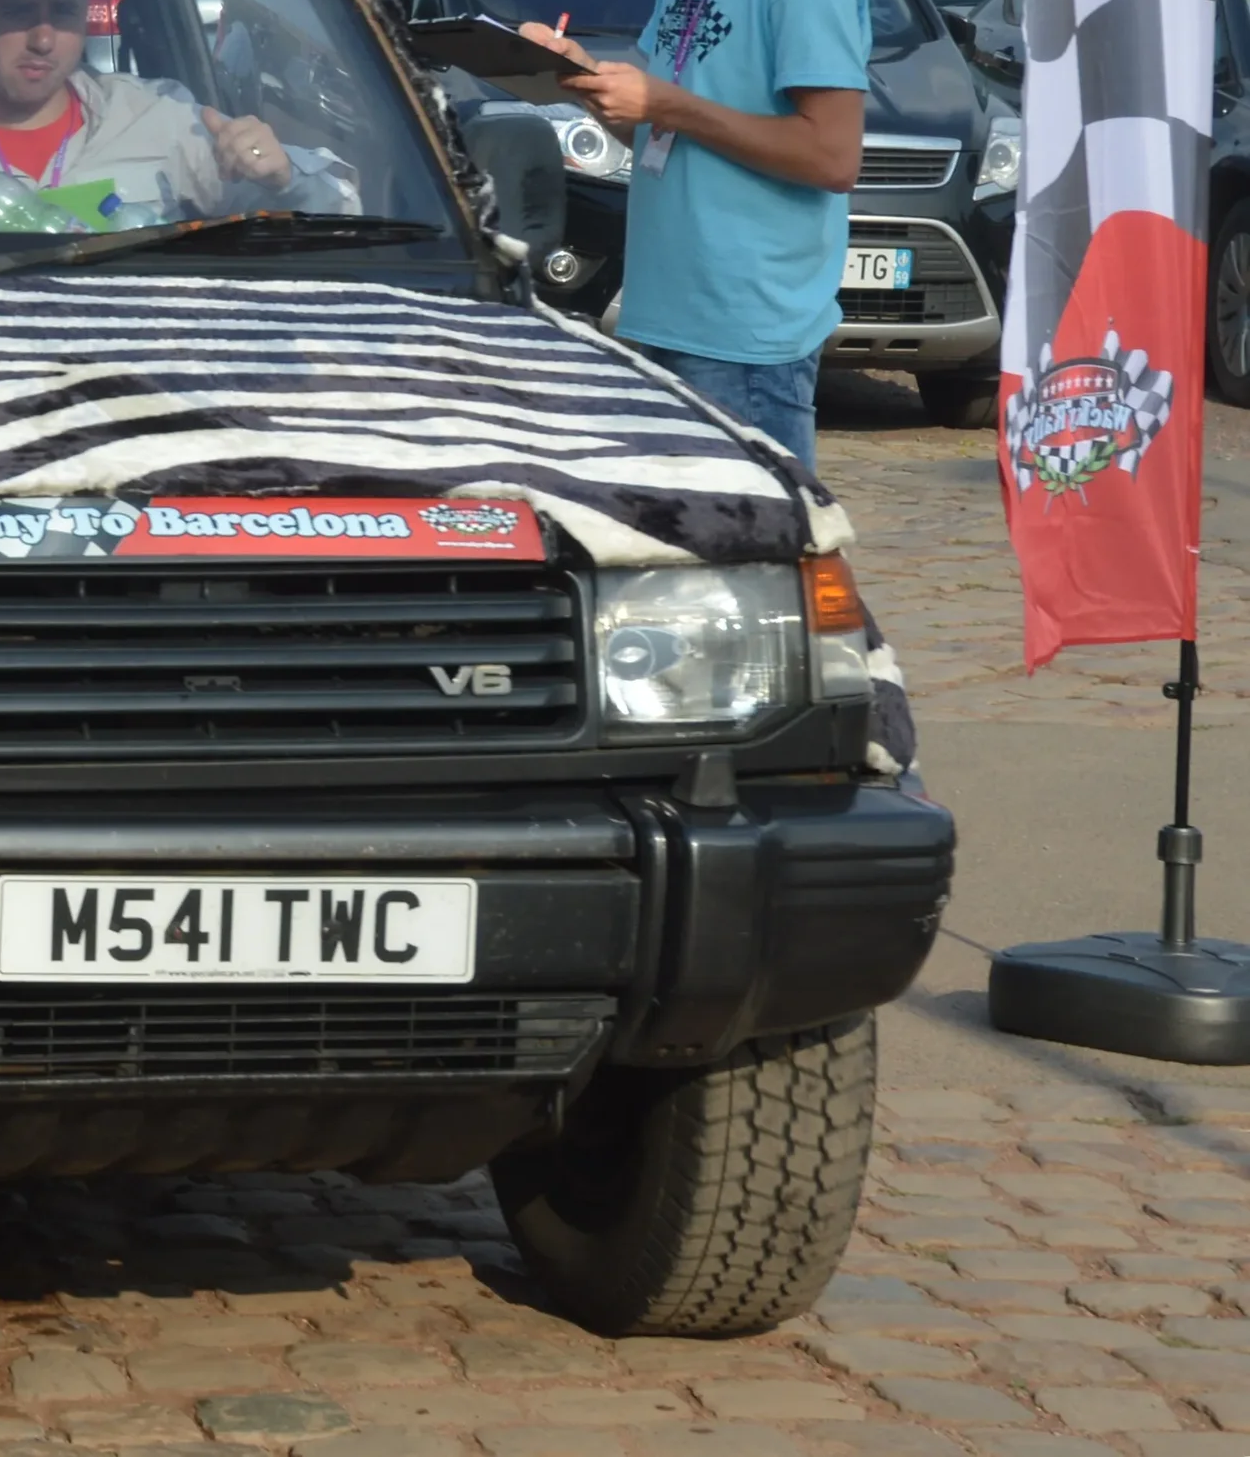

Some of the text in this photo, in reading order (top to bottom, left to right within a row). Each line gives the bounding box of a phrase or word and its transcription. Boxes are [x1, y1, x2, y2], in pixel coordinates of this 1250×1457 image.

[895, 270, 909, 285] 59
[63, 508, 135, 538] To
[147, 507, 411, 538] Barcelona
[429, 664, 512, 696] V6
[51, 888, 421, 963] M541 TWC
